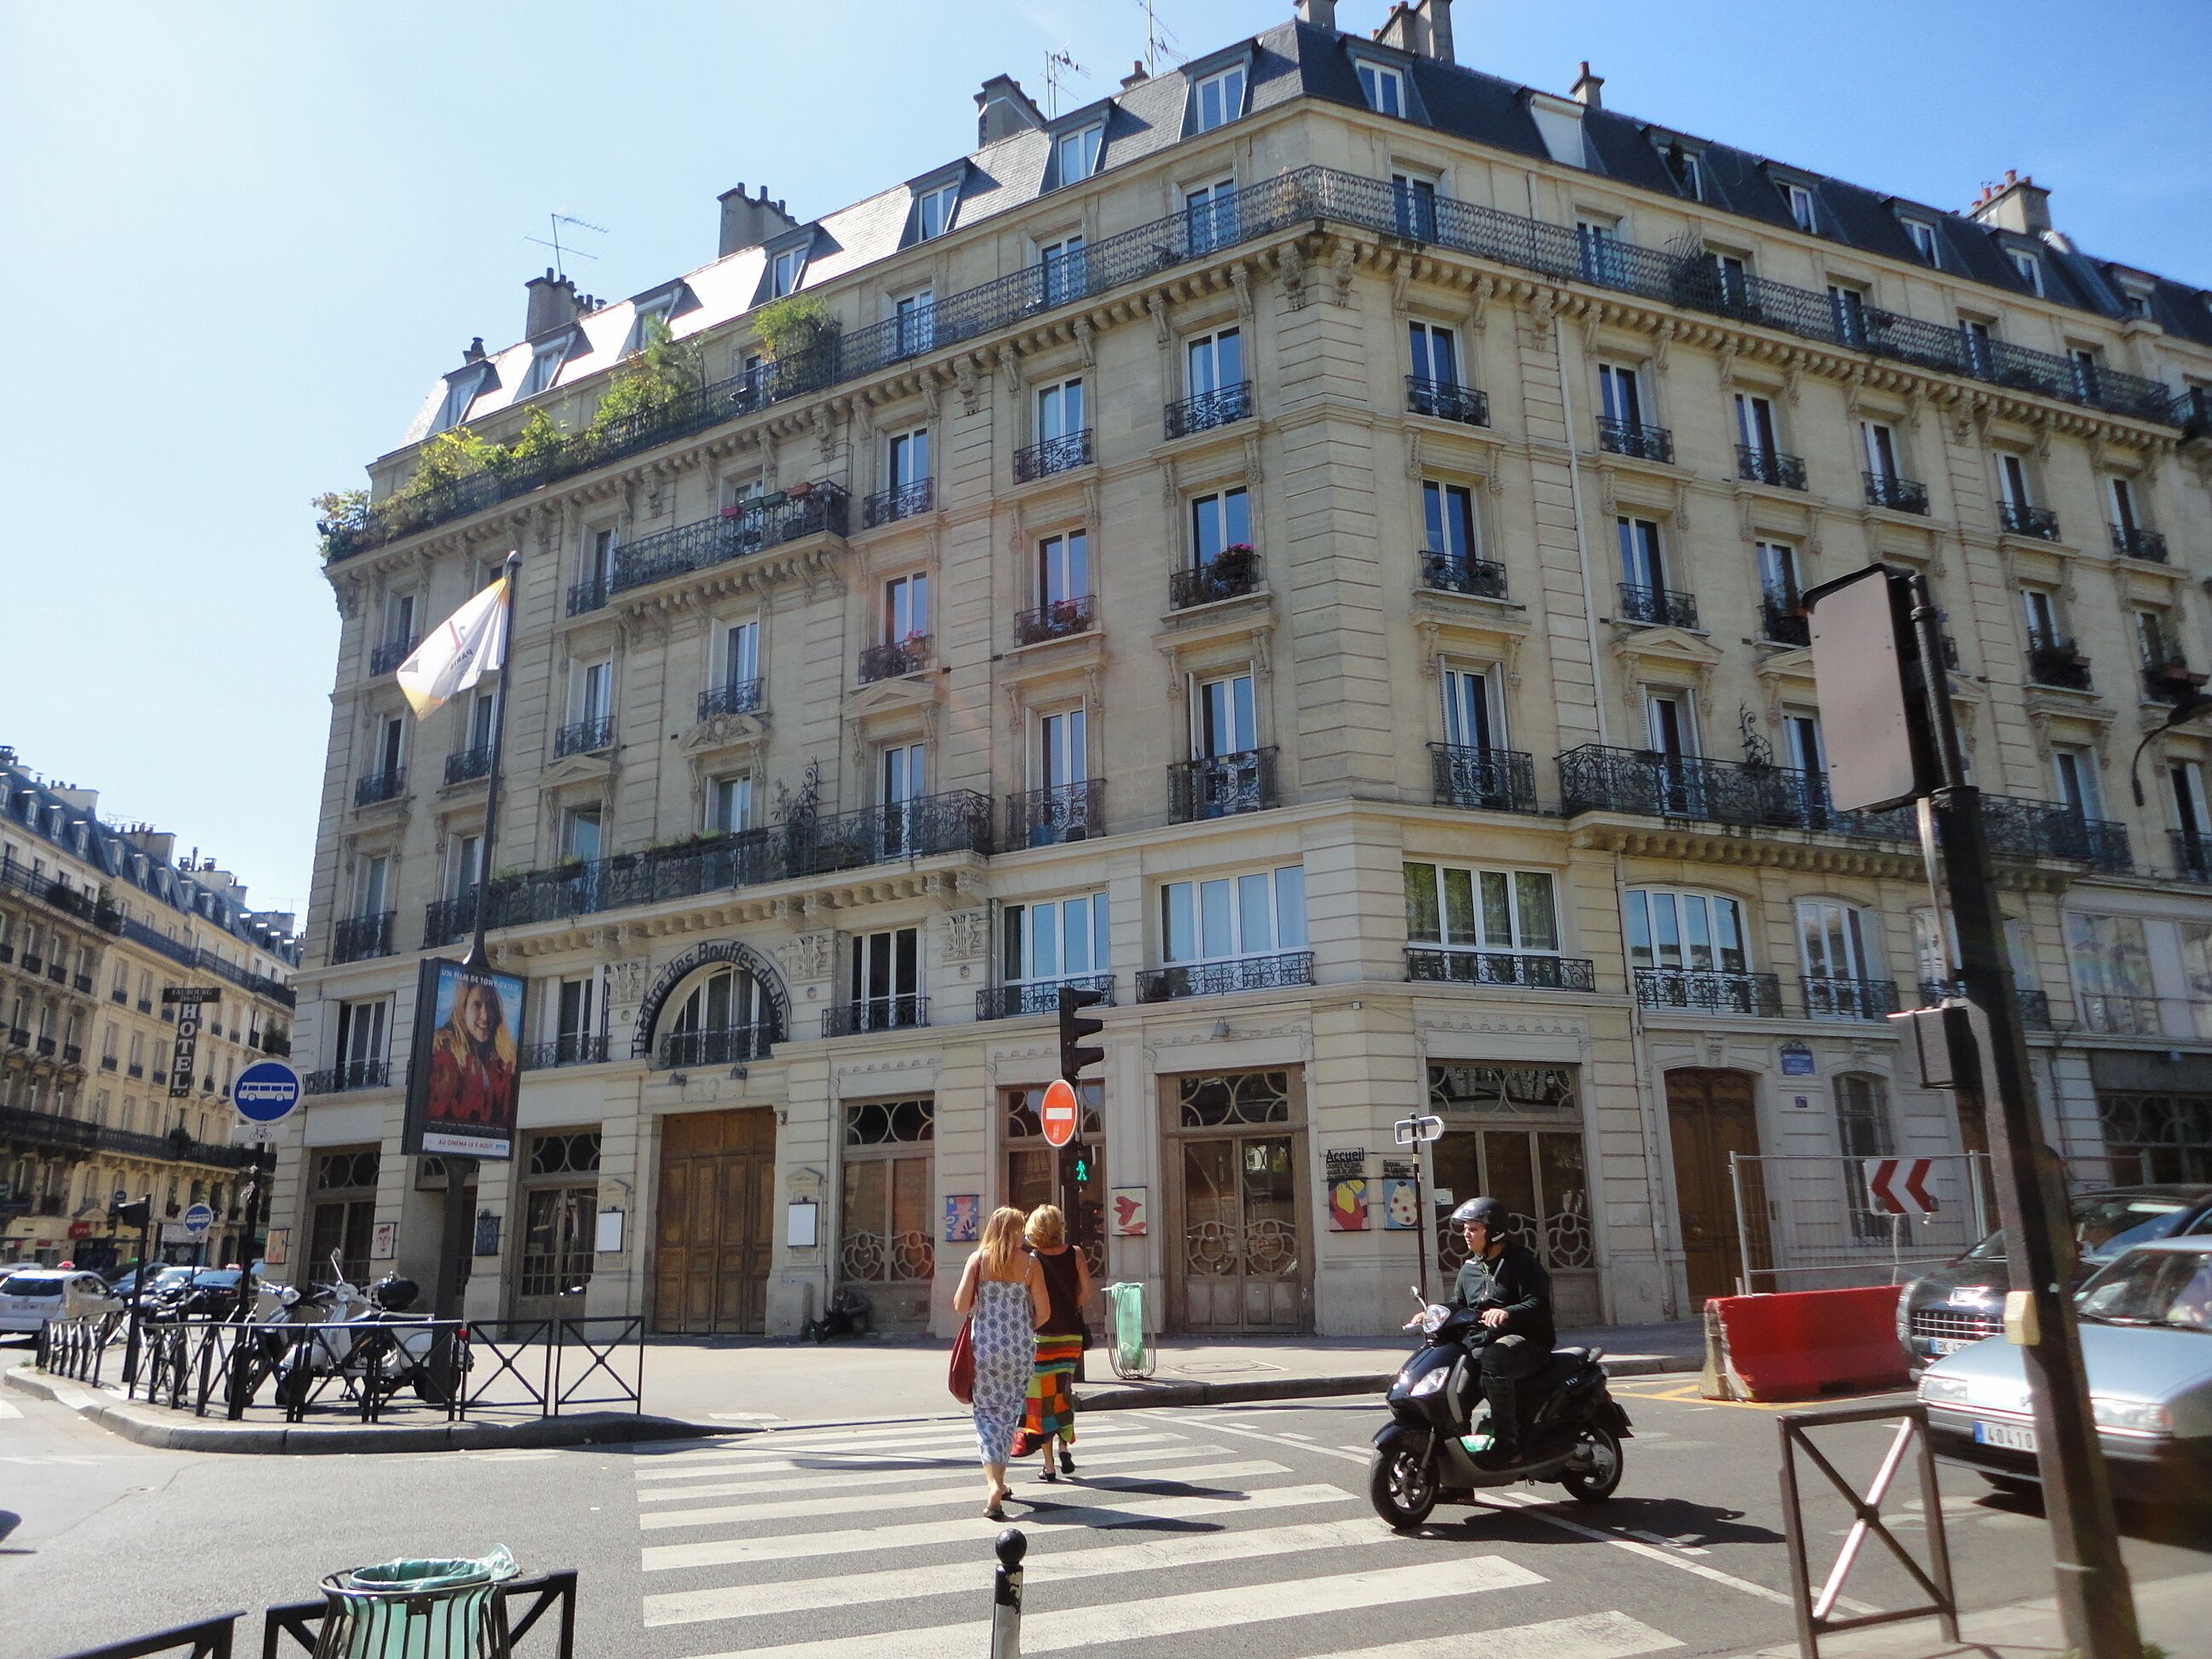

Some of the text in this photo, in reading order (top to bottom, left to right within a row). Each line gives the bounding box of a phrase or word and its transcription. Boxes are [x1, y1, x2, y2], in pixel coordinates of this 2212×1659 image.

[441, 969, 452, 977] UN
[454, 971, 469, 982] FILM
[667, 952, 694, 980] des
[698, 941, 758, 971] Bouffes
[756, 964, 775, 988] du
[173, 1004, 198, 1089] HOTEL
[1326, 1147, 1365, 1161] Accueil
